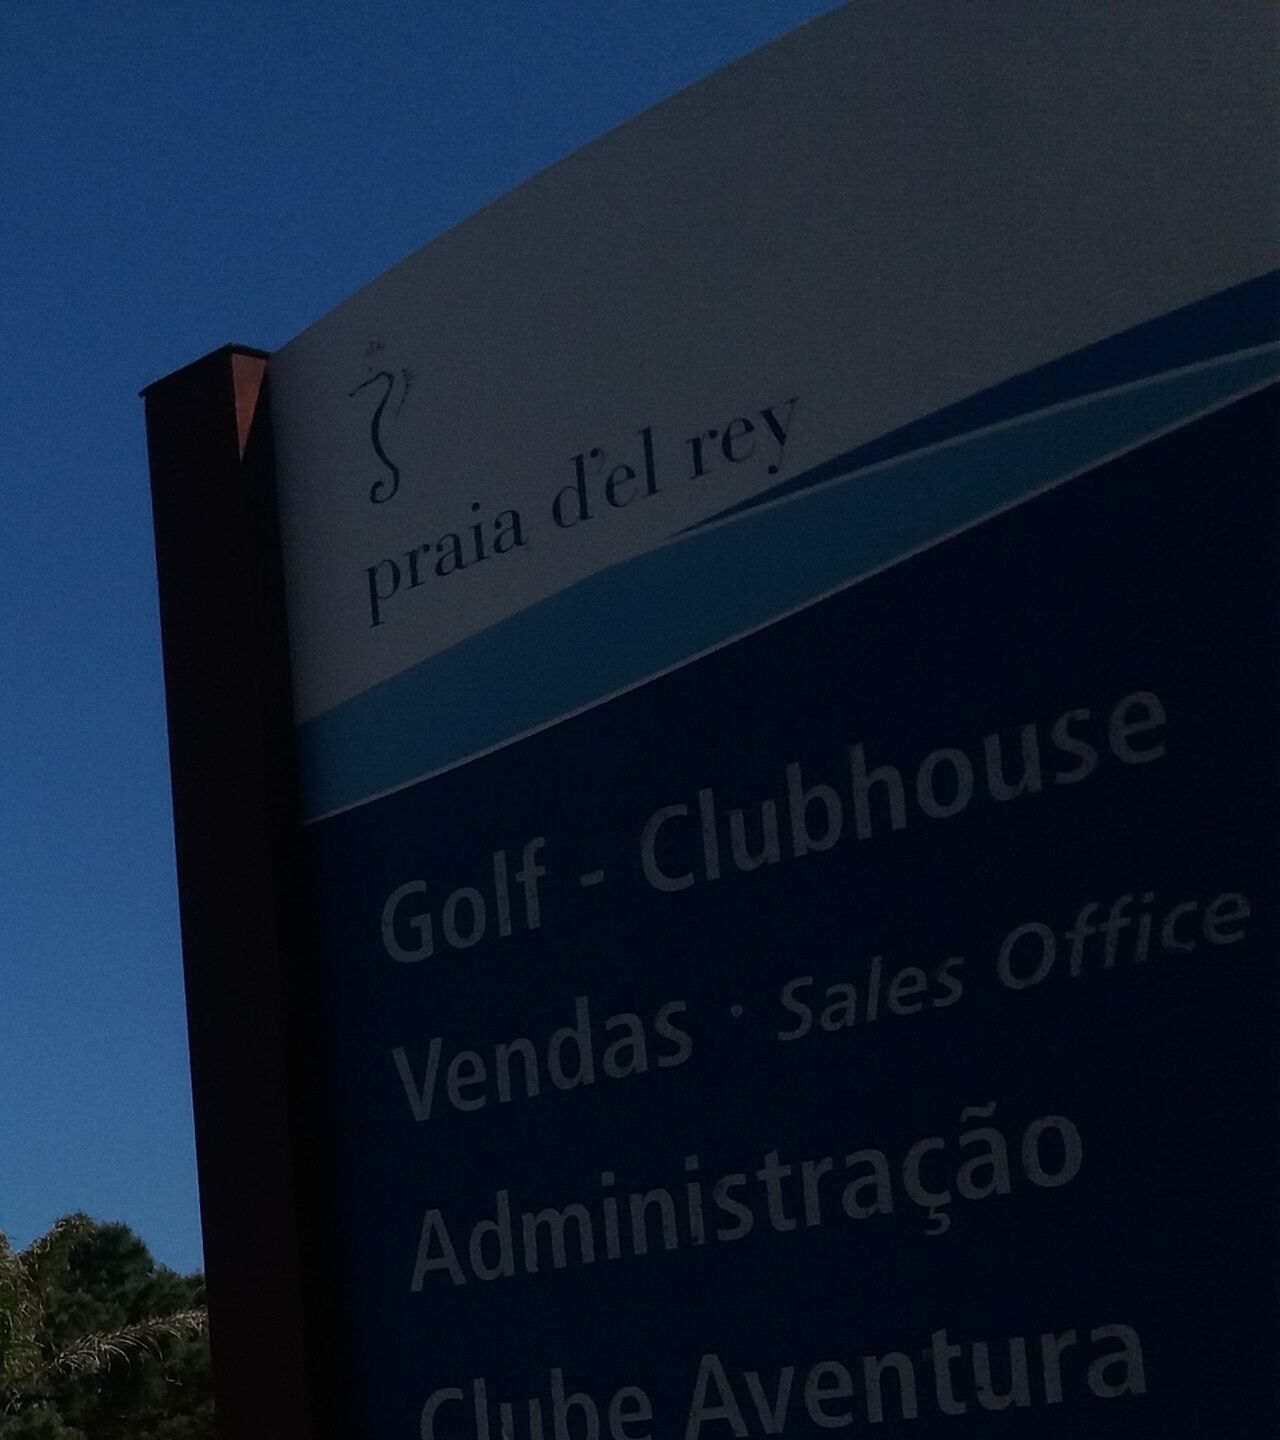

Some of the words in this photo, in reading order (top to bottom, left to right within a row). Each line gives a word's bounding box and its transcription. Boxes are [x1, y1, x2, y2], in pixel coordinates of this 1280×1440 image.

[364, 502, 528, 628] praia
[686, 396, 800, 479] rey
[379, 836, 547, 965] Golf
[640, 690, 1168, 894] Clubhouse
[391, 995, 694, 1122] Vendas
[777, 955, 964, 1043] Sales
[997, 889, 1252, 991] Office
[409, 1100, 1084, 1293] Administração
